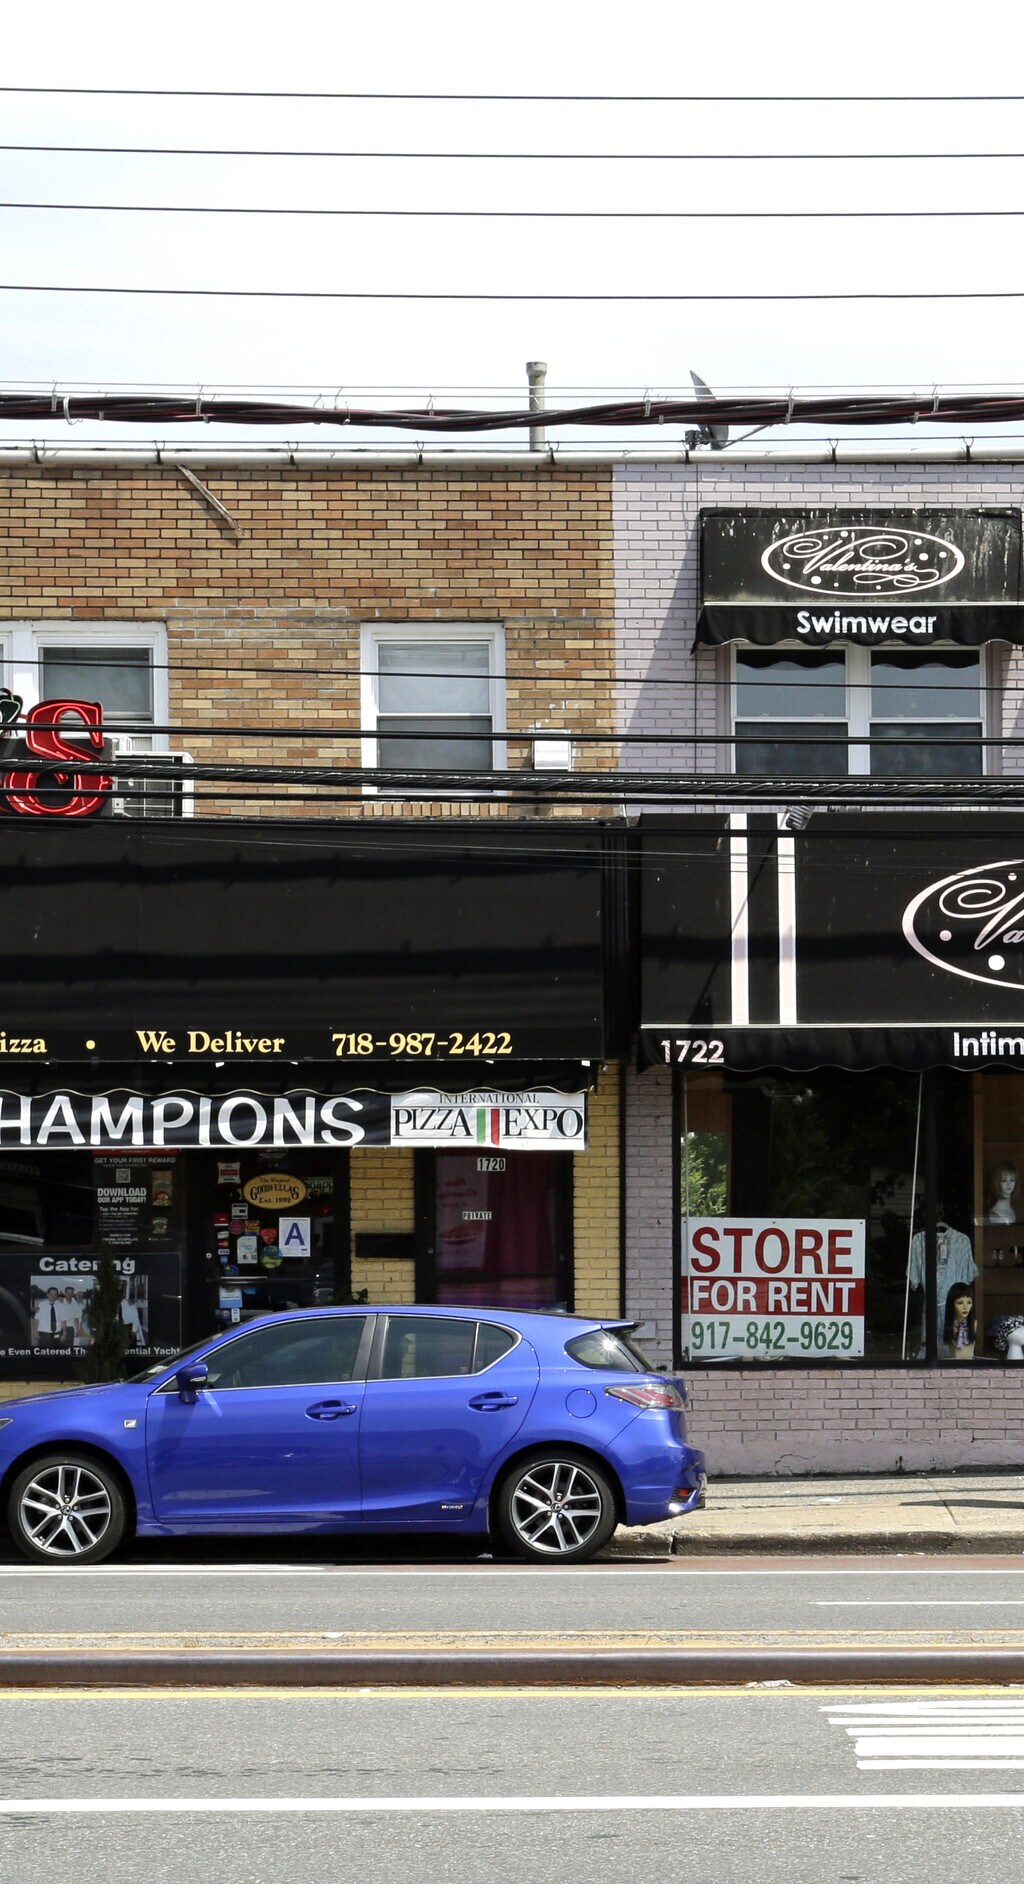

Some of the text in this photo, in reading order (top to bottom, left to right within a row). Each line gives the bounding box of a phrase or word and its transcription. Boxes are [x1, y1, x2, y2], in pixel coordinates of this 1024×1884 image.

[797, 611, 937, 634] Swimwear
[0, 1030, 513, 1056] izza We Deliver 718-987-2422
[660, 1039, 724, 1064] 1722
[439, 1093, 539, 1104] INTERNATIONAL
[393, 1108, 583, 1138] PIZZA EXPO
[479, 1159, 505, 1171] 1720
[97, 1187, 147, 1197] DOWNLOAD
[250, 1183, 300, 1201] GOODFELLAS
[463, 1211, 492, 1220] PRIVATE
[284, 1222, 306, 1246] A
[690, 1226, 853, 1275] STORE
[39, 1256, 136, 1275] Caterng
[692, 1279, 856, 1313] FOR RENT
[691, 1321, 854, 1350] 917-842-9629
[8, 1348, 31, 1356] Even
[33, 1347, 71, 1356] Catered
[73, 1347, 88, 1355] Th
[153, 1347, 180, 1355] Yacht
